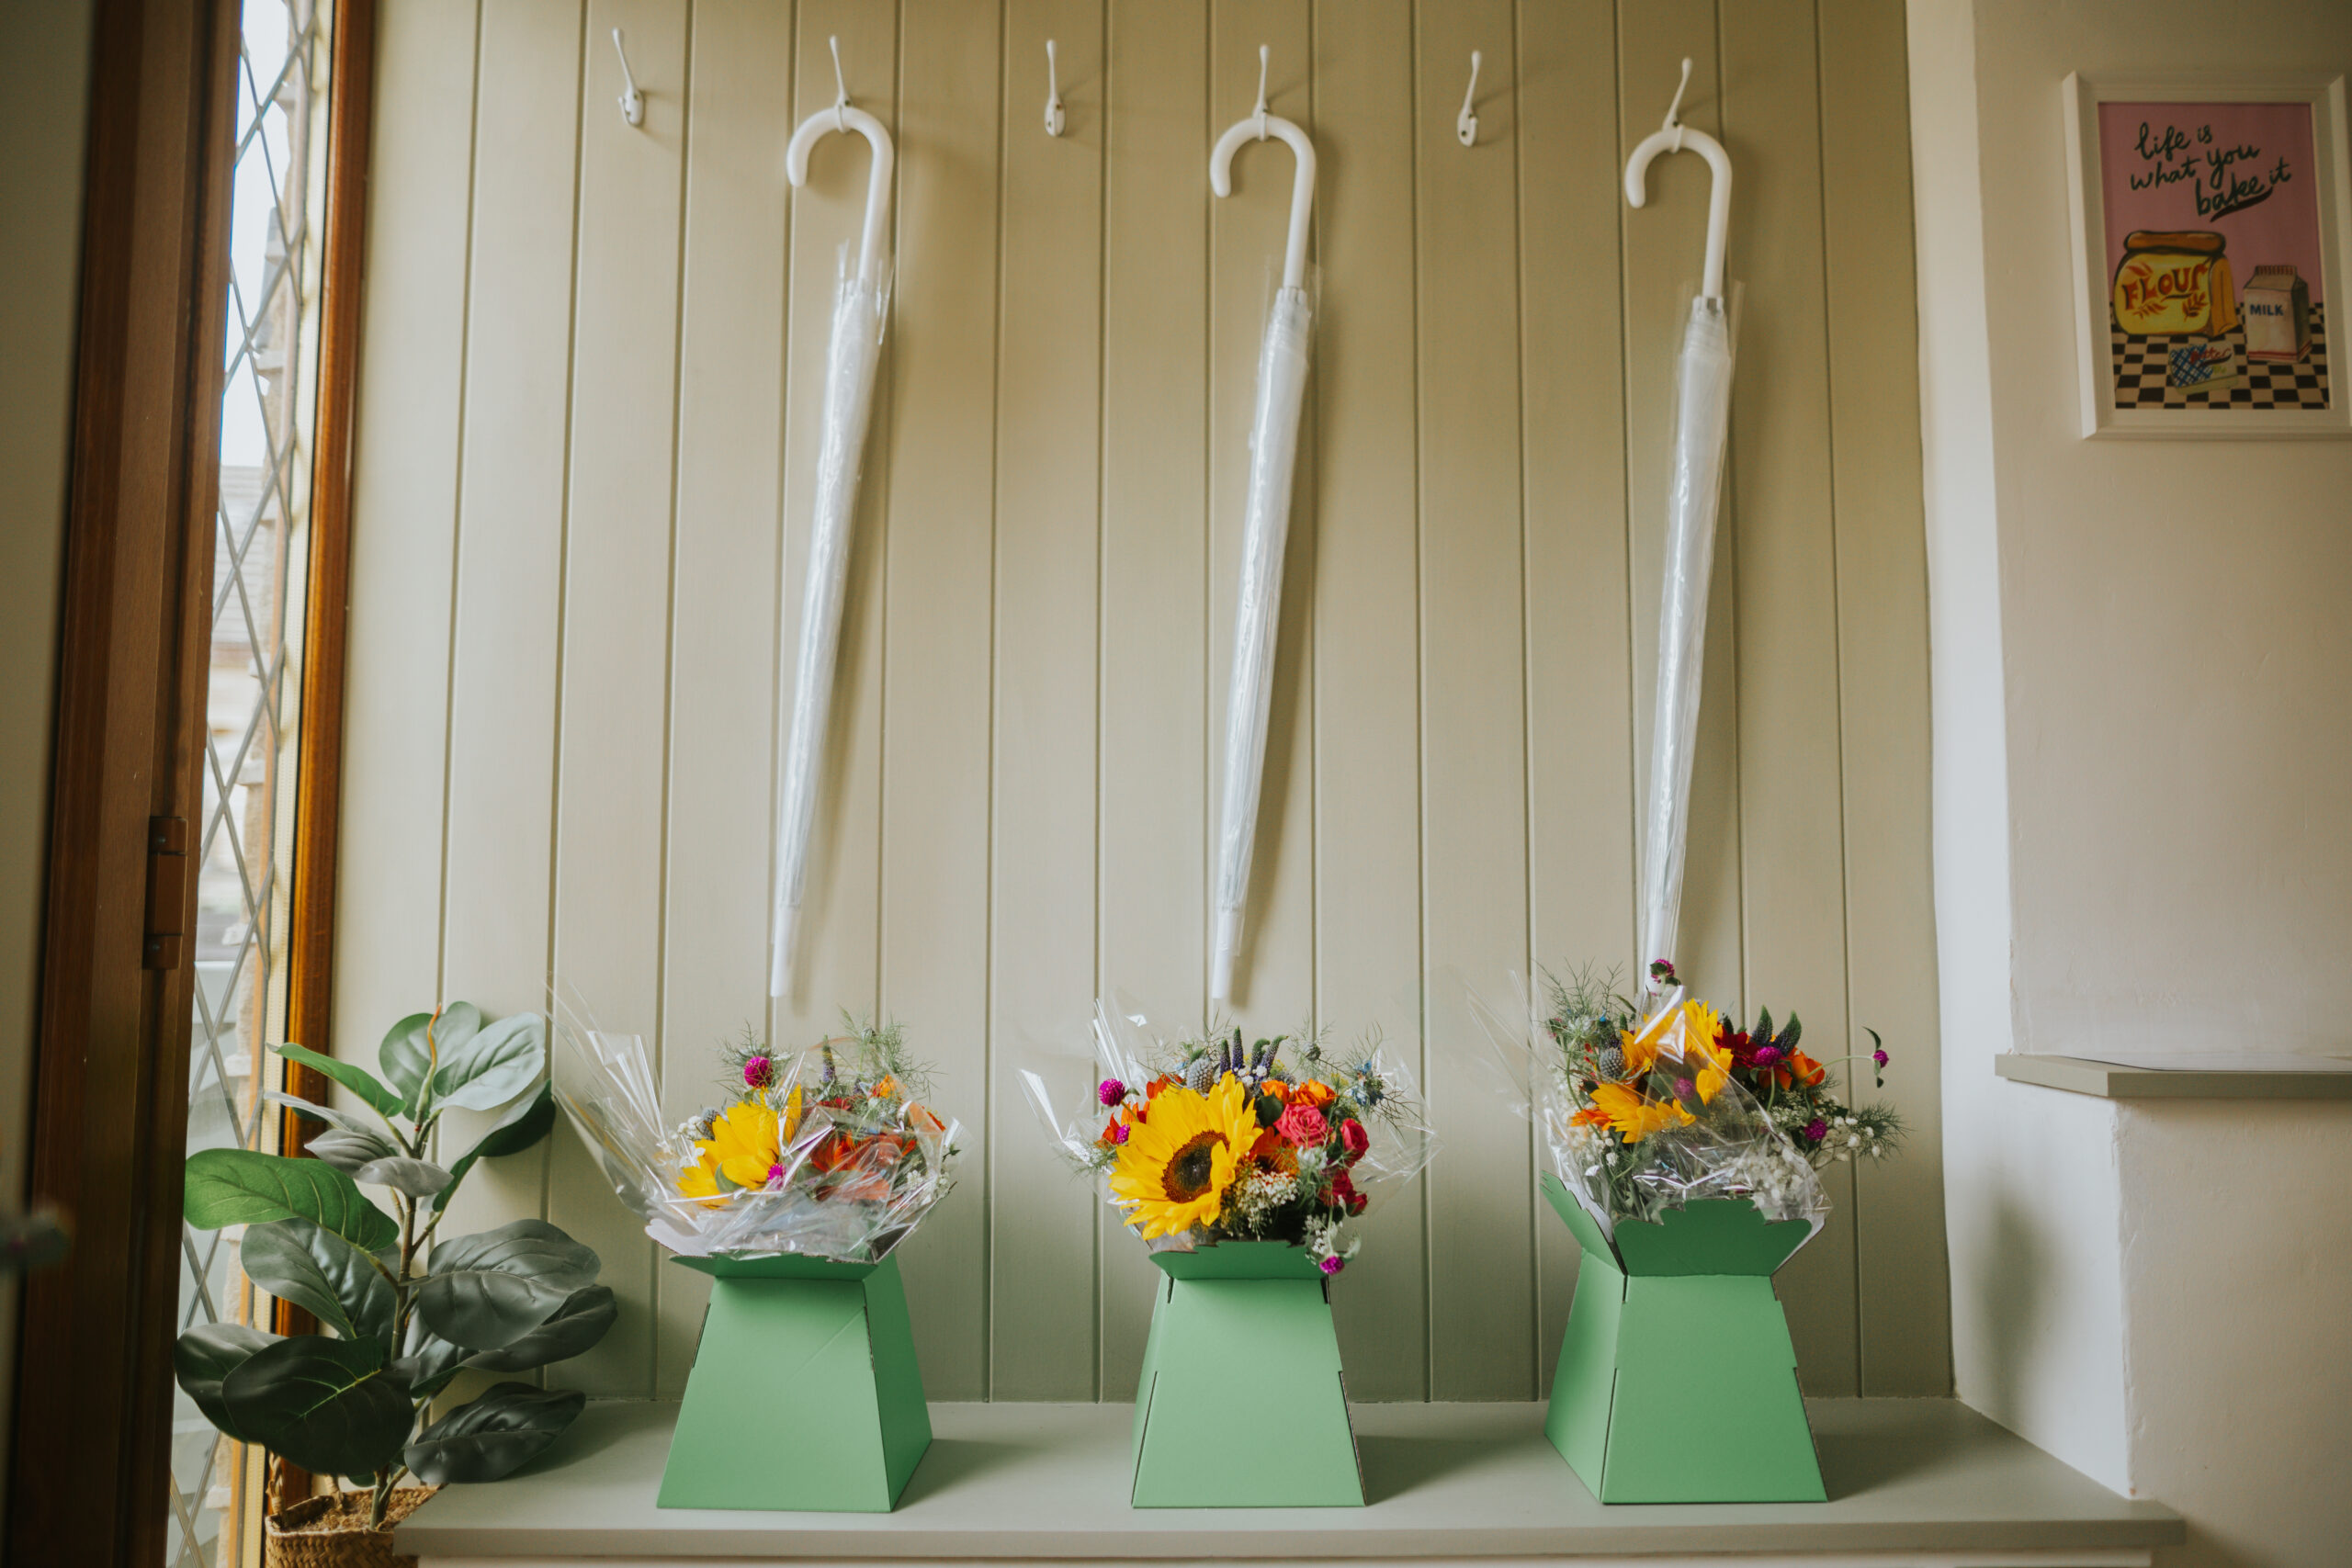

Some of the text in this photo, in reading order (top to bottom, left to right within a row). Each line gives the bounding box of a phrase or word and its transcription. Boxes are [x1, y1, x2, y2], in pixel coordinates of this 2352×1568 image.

[2134, 121, 2212, 161] life is
[2131, 144, 2260, 190] what you
[2195, 156, 2291, 216] bake it
[2250, 304, 2284, 316] MILK
